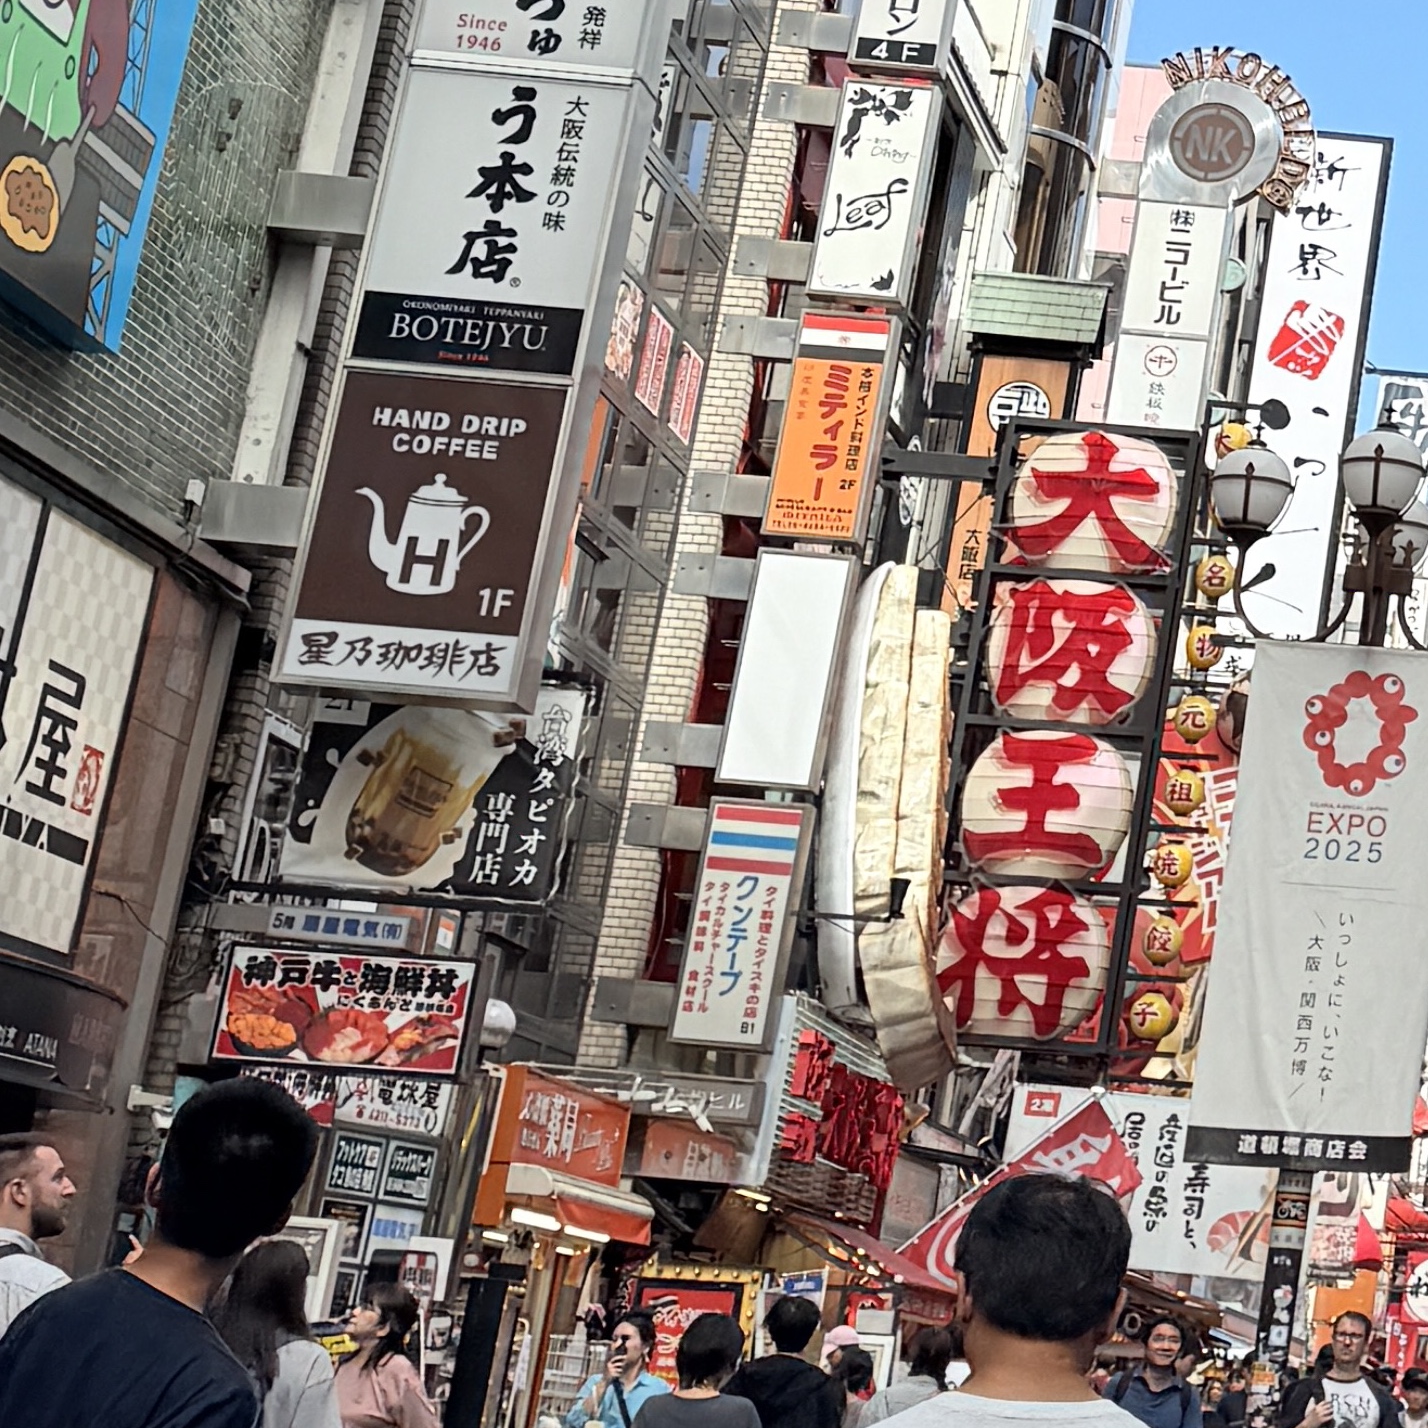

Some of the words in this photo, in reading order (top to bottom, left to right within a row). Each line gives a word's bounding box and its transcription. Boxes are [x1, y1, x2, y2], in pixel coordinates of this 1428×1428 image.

[457, 14, 508, 32] Since
[456, 34, 502, 52] 1946
[1185, 123, 1236, 165] NK
[542, 95, 589, 232] 大阪伝統の味
[389, 313, 549, 351] BOTEJYU
[372, 406, 451, 432] HAND
[461, 414, 527, 438] DRIP
[810, 364, 852, 502] ミティラー
[392, 433, 500, 460] COFFEE
[478, 588, 515, 617] 1F
[297, 631, 507, 682] 星乃珈琲店
[936, 430, 1176, 1037] 大阪王将
[468, 792, 517, 887] 専門店
[1307, 812, 1387, 838] EXPO
[1304, 838, 1384, 863] 2025
[718, 875, 760, 997] クンテープ
[1238, 1133, 1368, 1161] 道頓堀商店会
